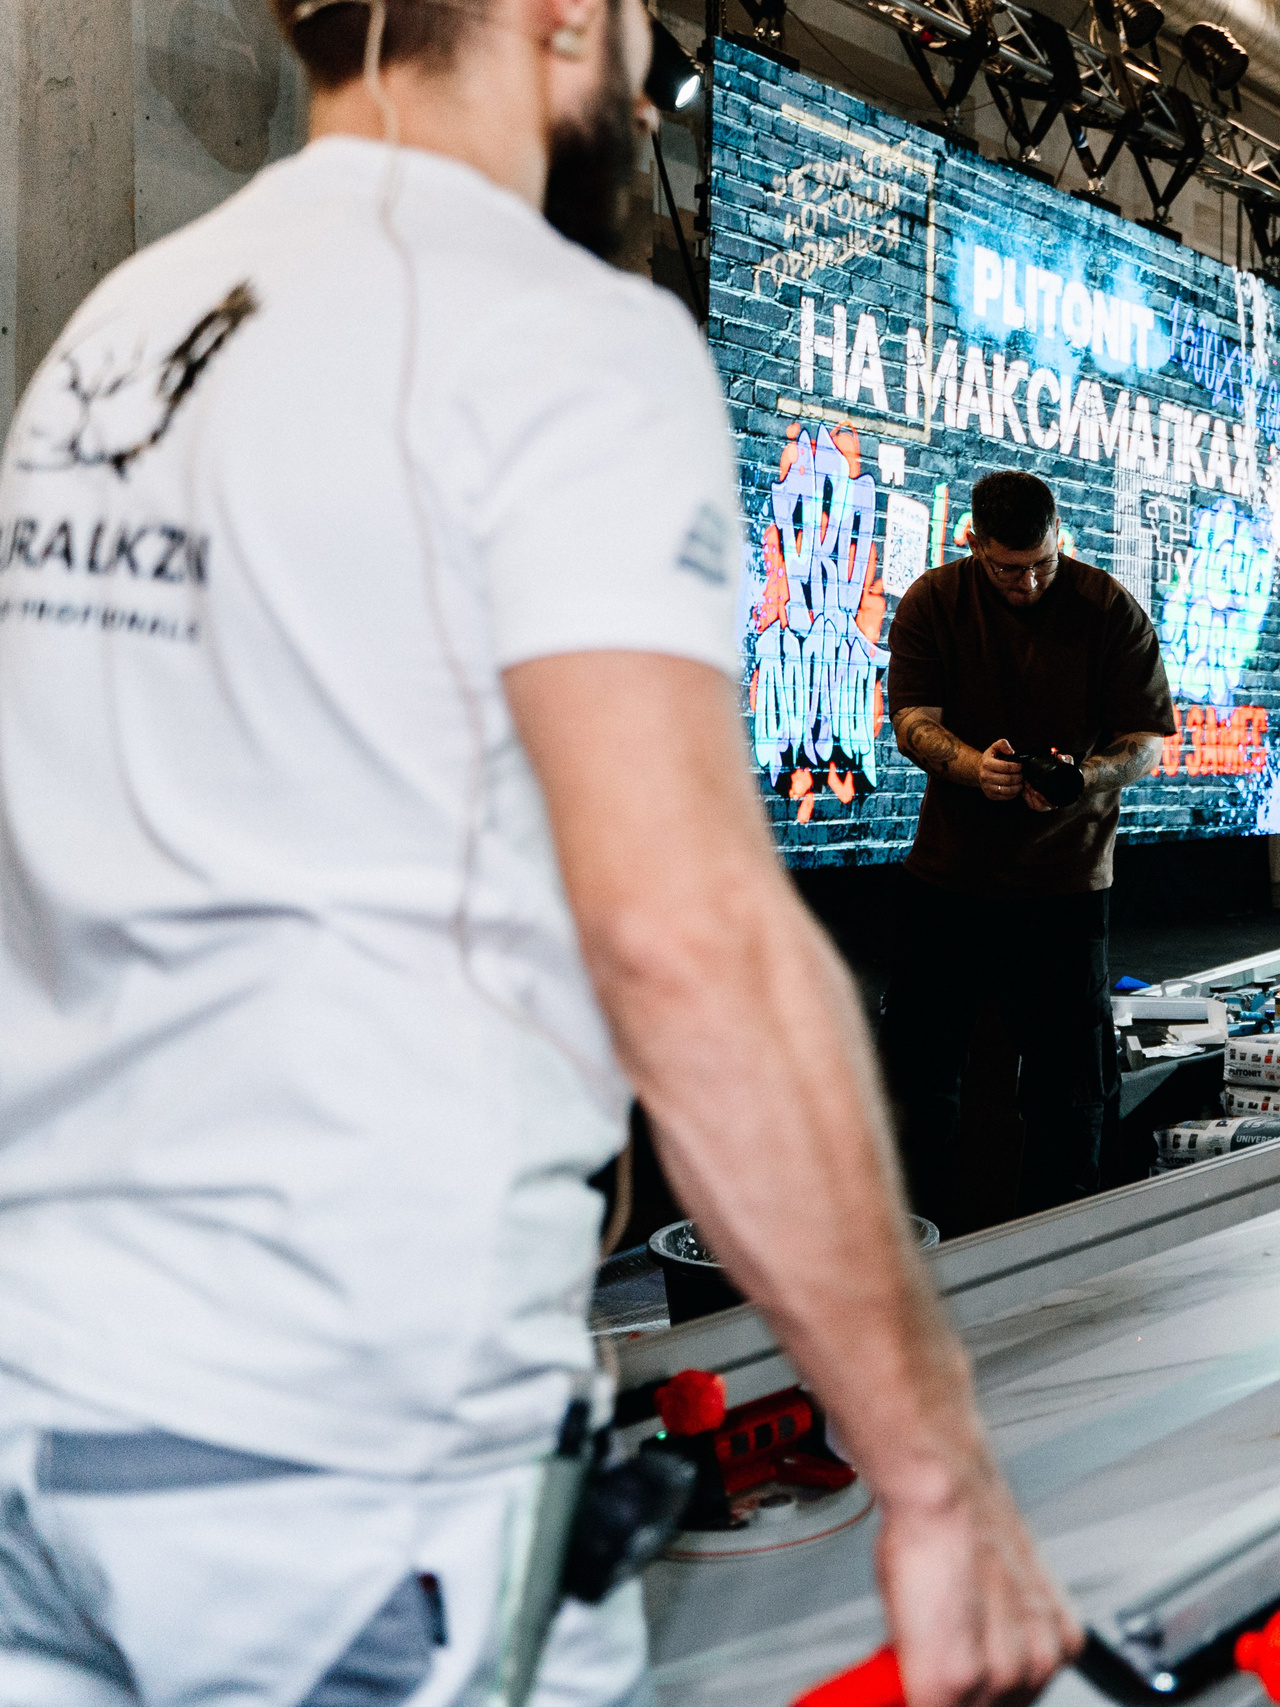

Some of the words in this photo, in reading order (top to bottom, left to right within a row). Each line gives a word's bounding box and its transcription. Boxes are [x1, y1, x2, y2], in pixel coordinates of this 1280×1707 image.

[972, 244, 1155, 370] PLITONIT
[799, 295, 890, 412] НА
[904, 326, 1254, 497] МАКСИМАЛКАХ
[771, 421, 876, 637] PRO
[1228, 1069, 1262, 1078] PLITONIT
